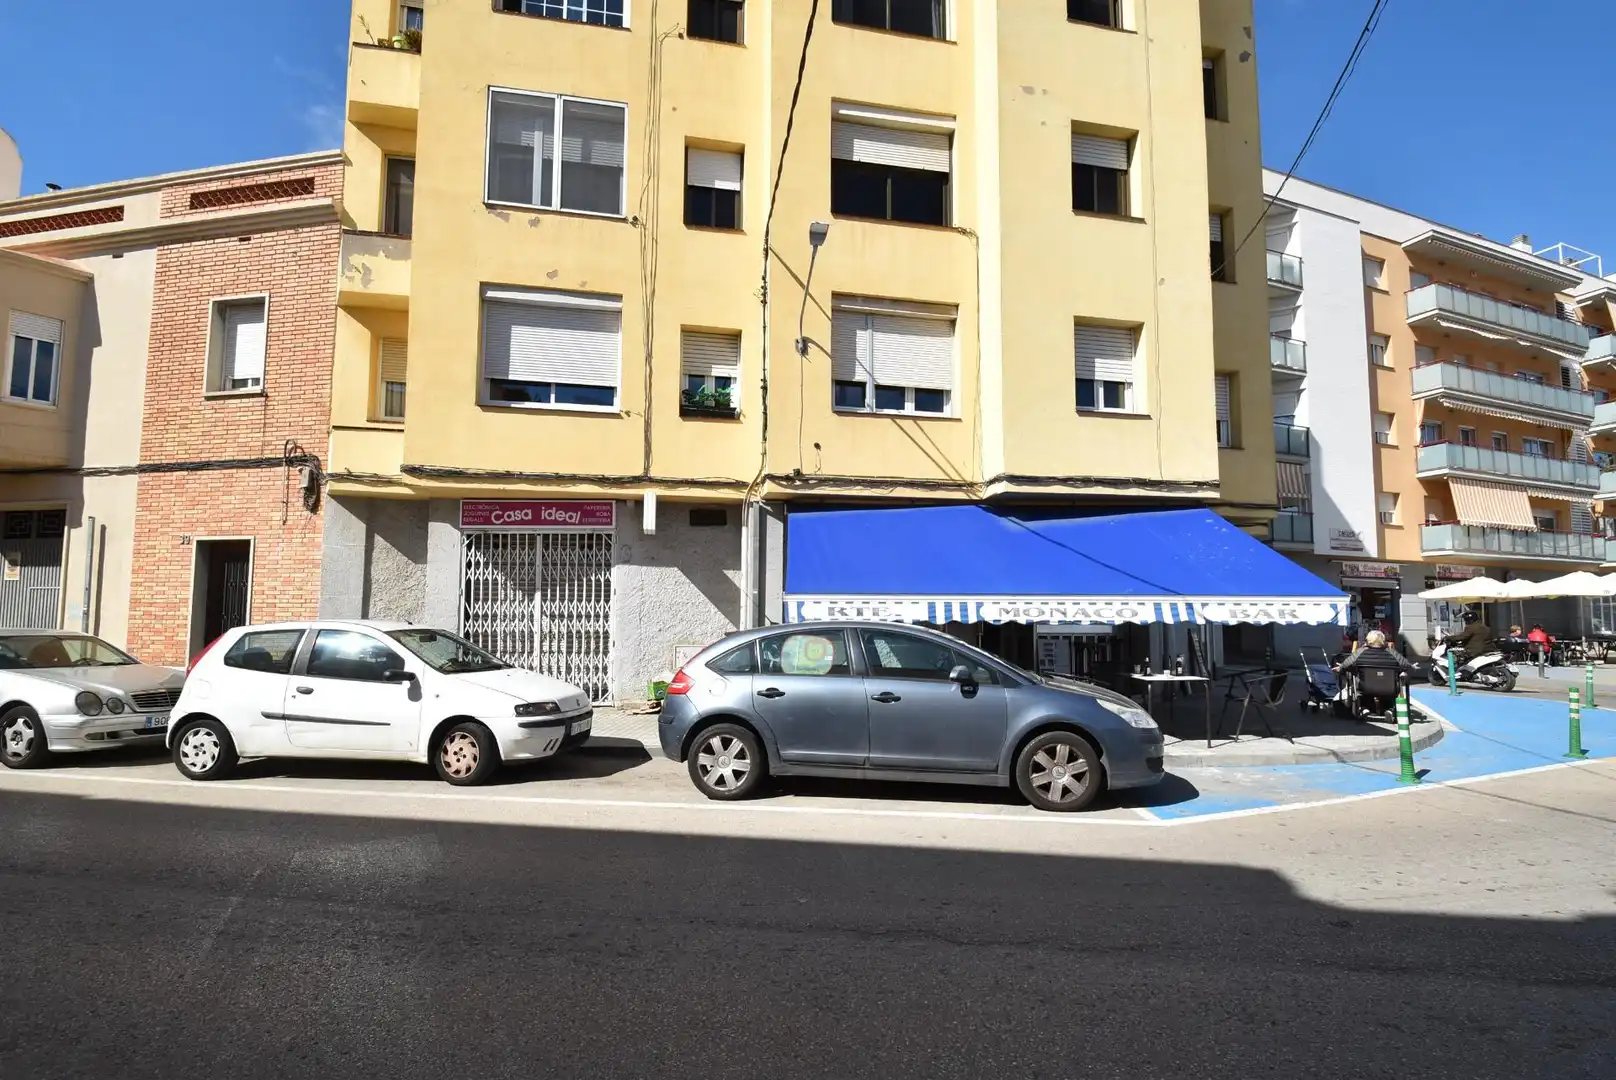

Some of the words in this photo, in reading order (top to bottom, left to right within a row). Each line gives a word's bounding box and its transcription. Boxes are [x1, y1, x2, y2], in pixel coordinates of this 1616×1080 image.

[491, 509, 532, 524] Casa
[541, 506, 581, 524] ideal
[998, 607, 1139, 619] MONACO
[1229, 608, 1299, 620] BAR
